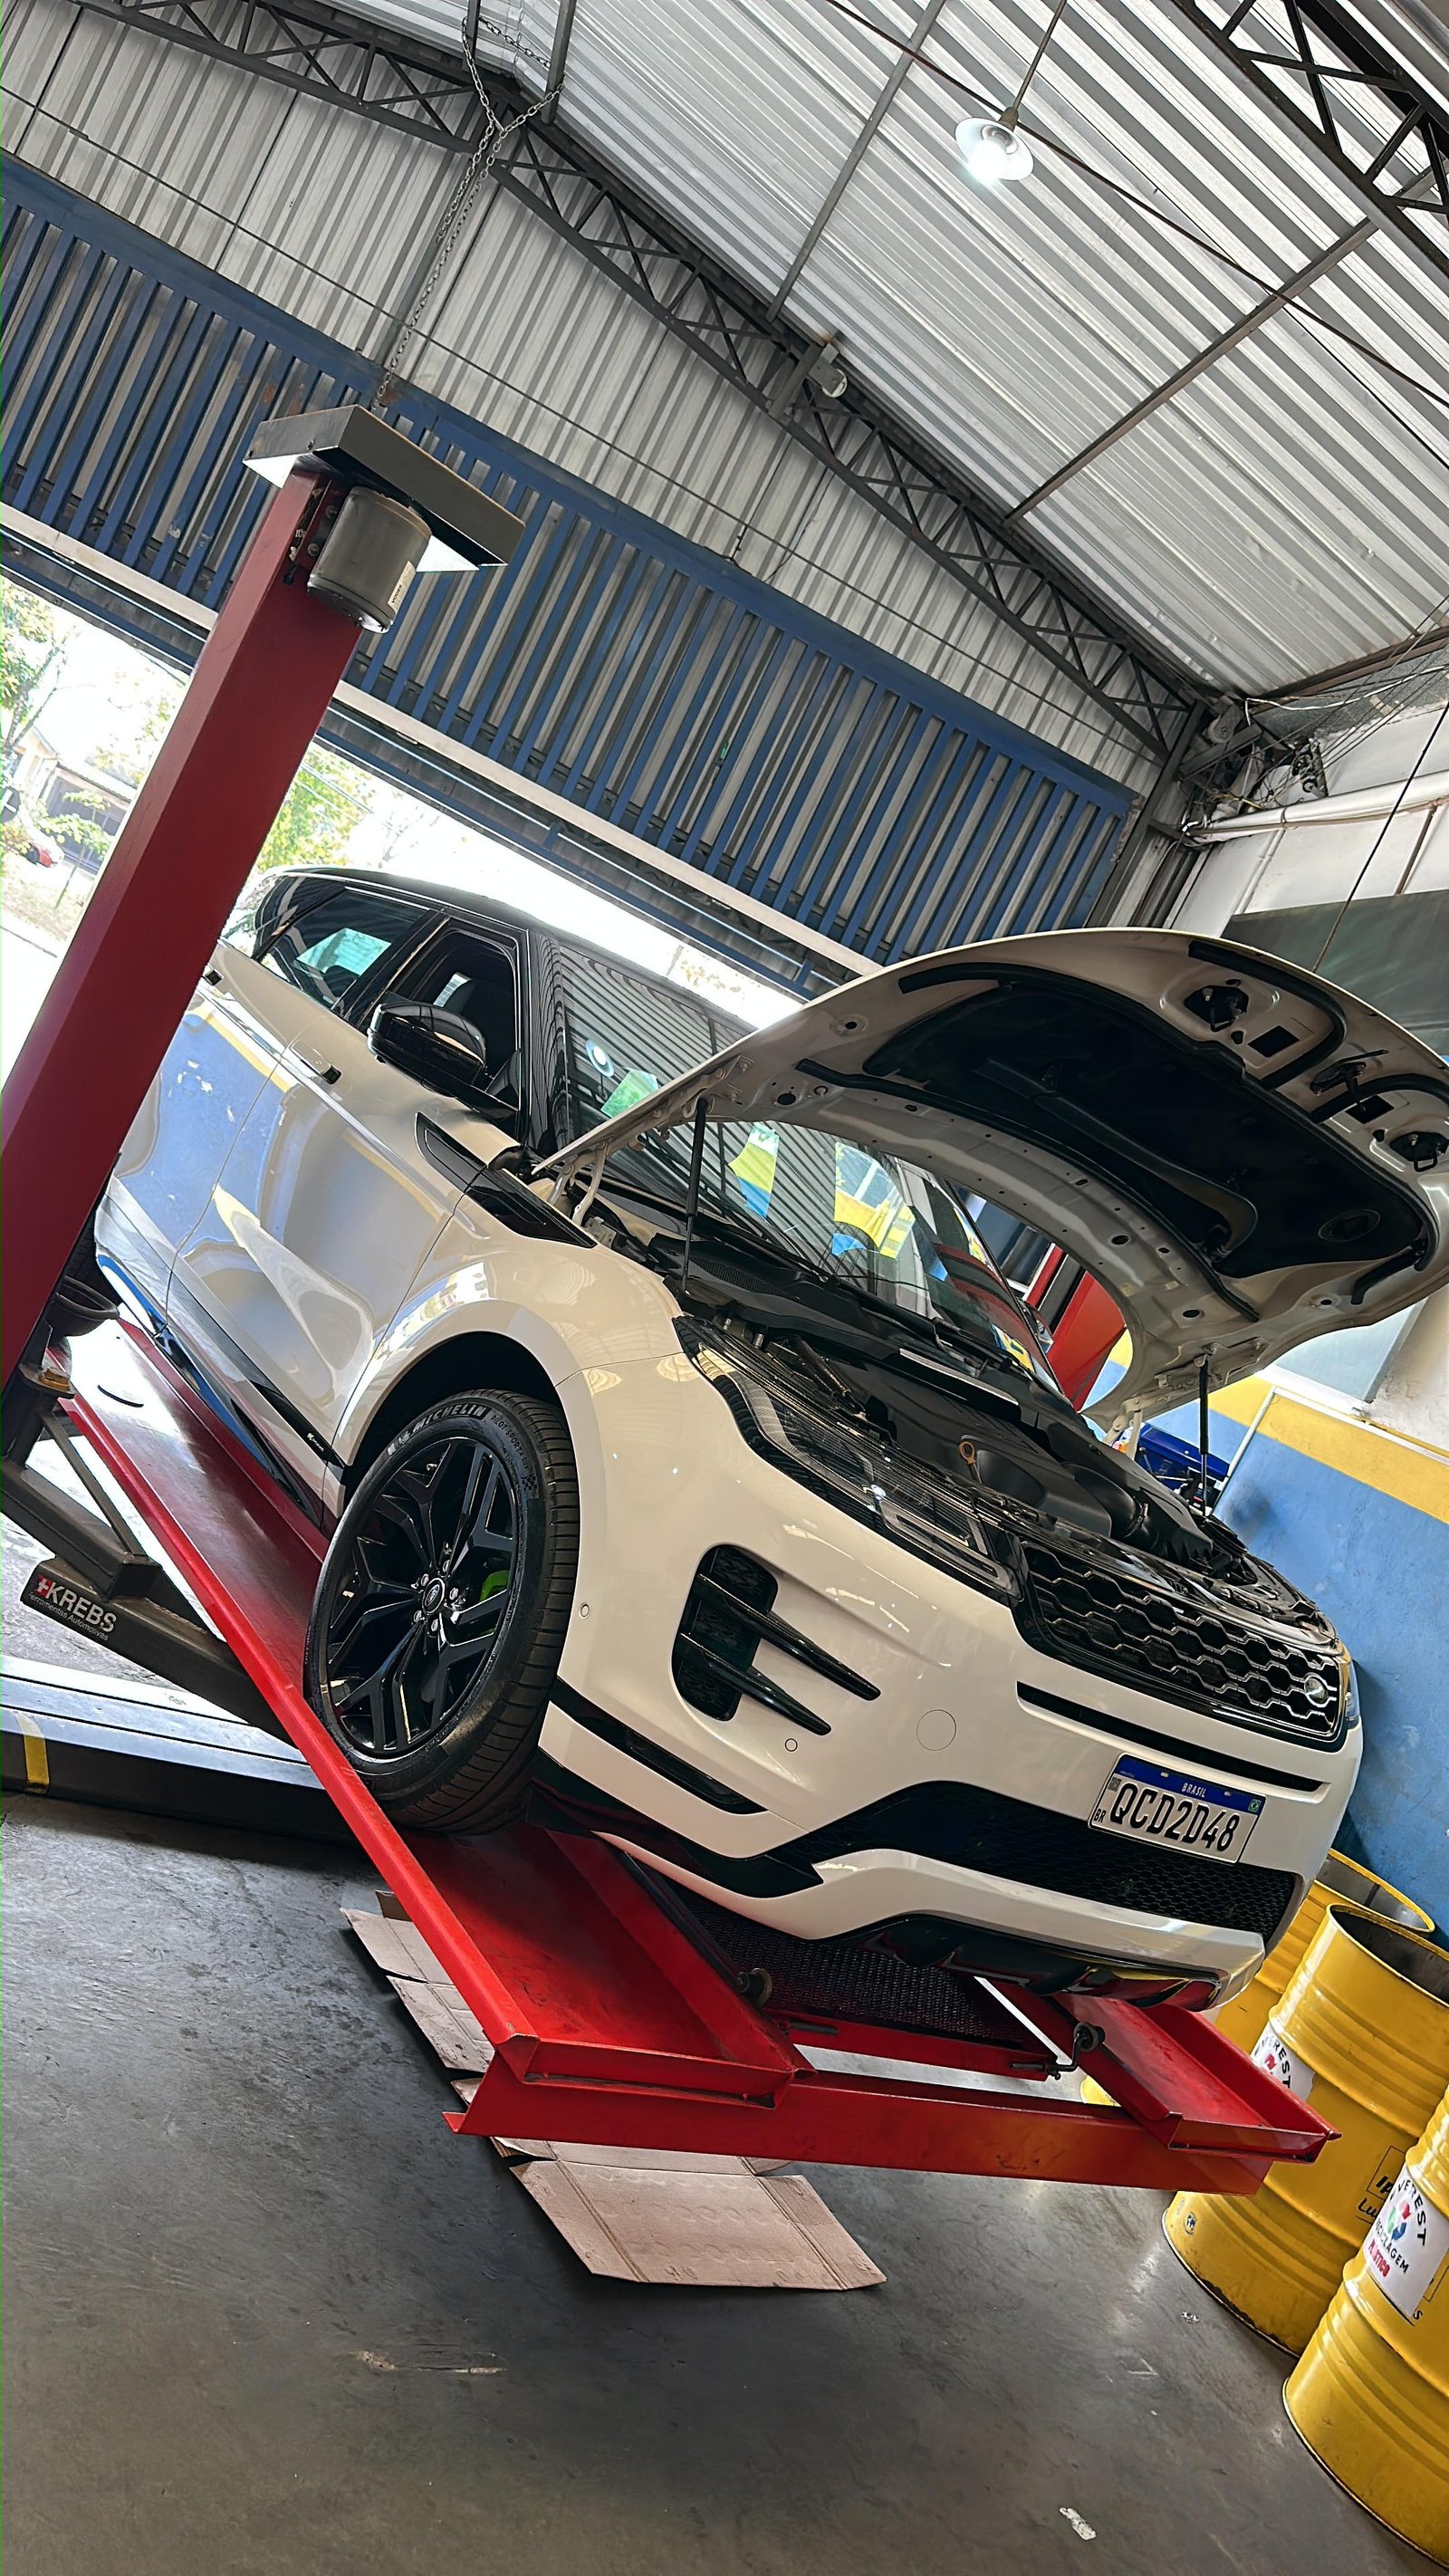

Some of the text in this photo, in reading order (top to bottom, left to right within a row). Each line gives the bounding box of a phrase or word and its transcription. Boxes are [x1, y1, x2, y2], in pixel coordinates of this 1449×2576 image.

[412, 1404, 487, 1433] MICHELIN
[490, 1415, 508, 1430] PILOT
[505, 1429, 523, 1452] SPORT
[45, 1581, 117, 1632] KREBS
[1181, 1783, 1206, 1798] BRASIL
[1093, 1808, 1107, 1823] BR
[1109, 1783, 1240, 1851] QCD2D48
